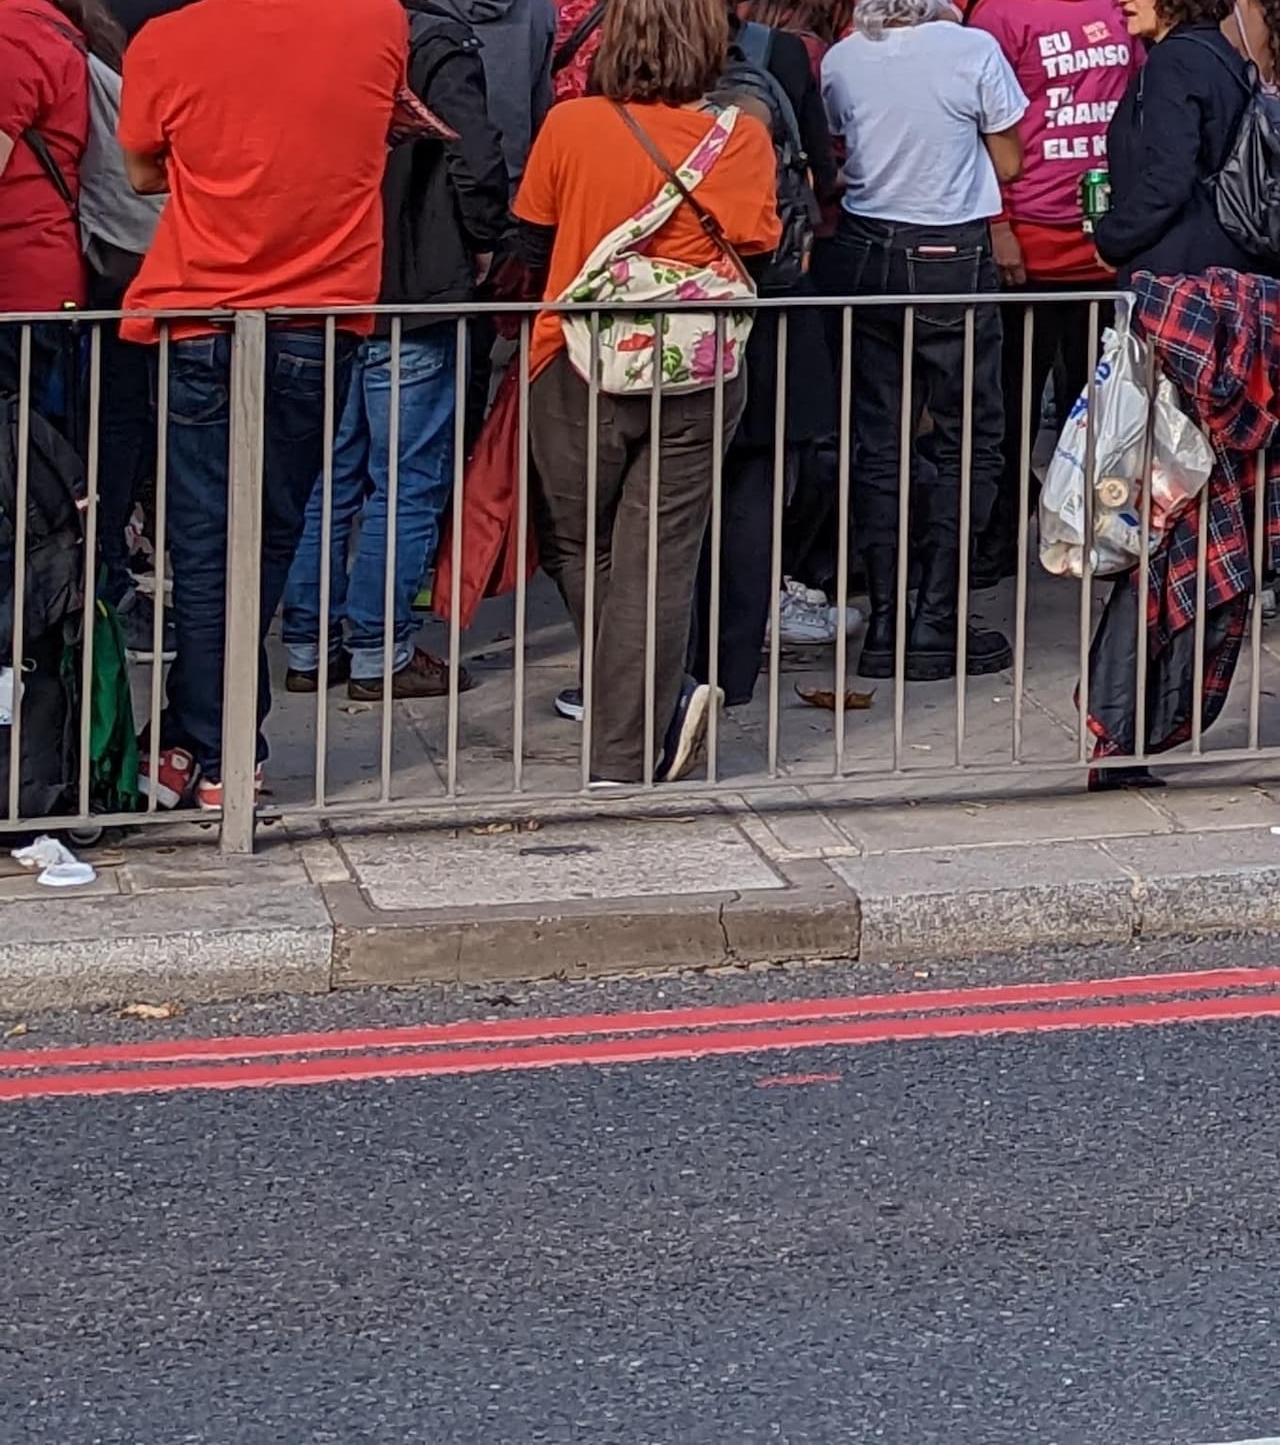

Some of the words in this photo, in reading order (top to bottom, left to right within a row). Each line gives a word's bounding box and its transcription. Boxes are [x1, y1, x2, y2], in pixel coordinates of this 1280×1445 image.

[1038, 30, 1072, 55] EU
[1042, 44, 1130, 78] TRANSO
[1043, 136, 1088, 160] ELE
